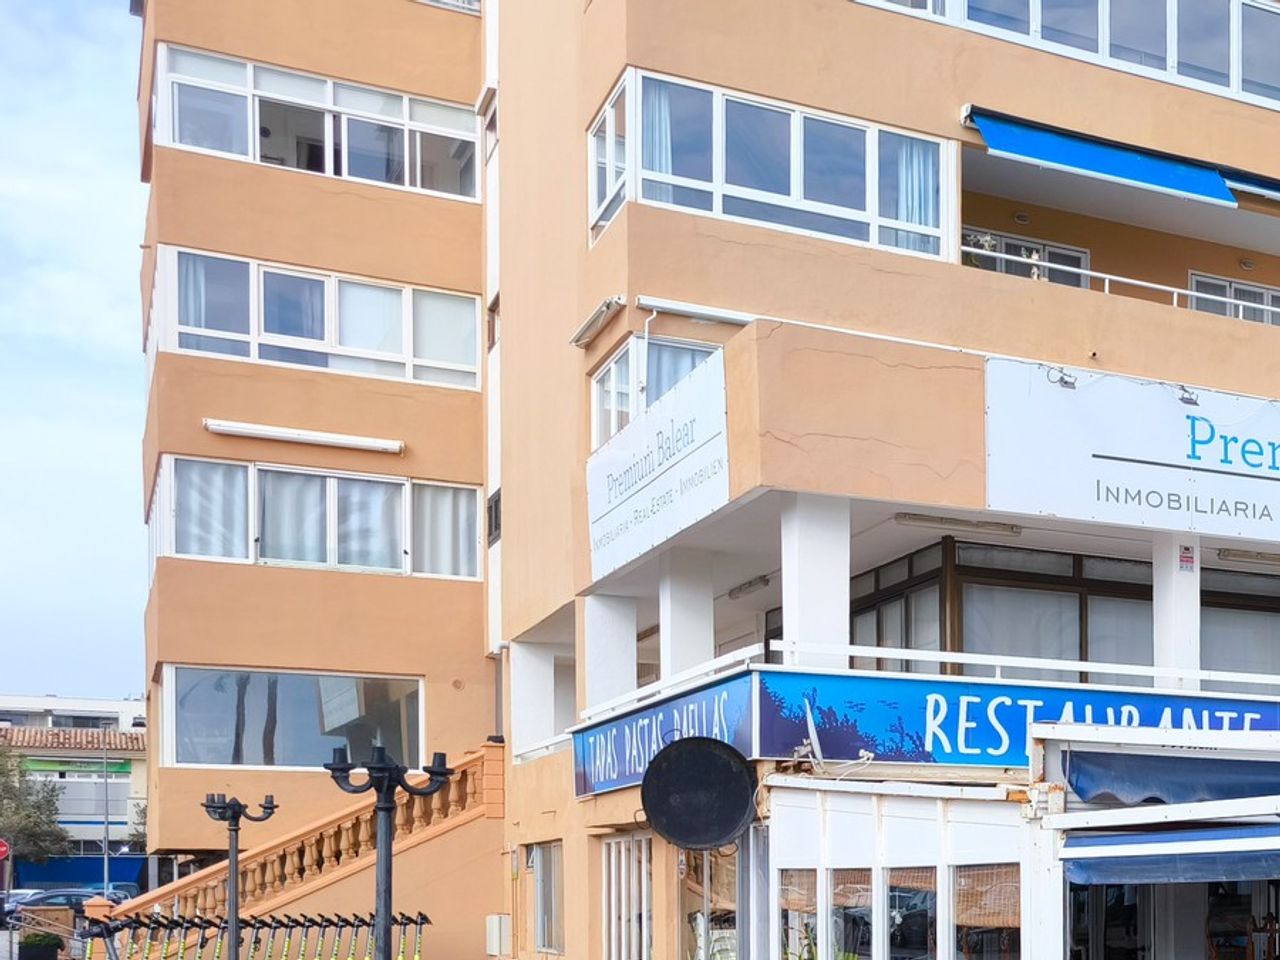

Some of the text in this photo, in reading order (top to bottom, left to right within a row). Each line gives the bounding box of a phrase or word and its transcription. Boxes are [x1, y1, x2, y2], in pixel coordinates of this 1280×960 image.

[606, 417, 697, 504] Premium Balear
[588, 727, 619, 784] TAPAS
[624, 712, 665, 776] PASTAS
